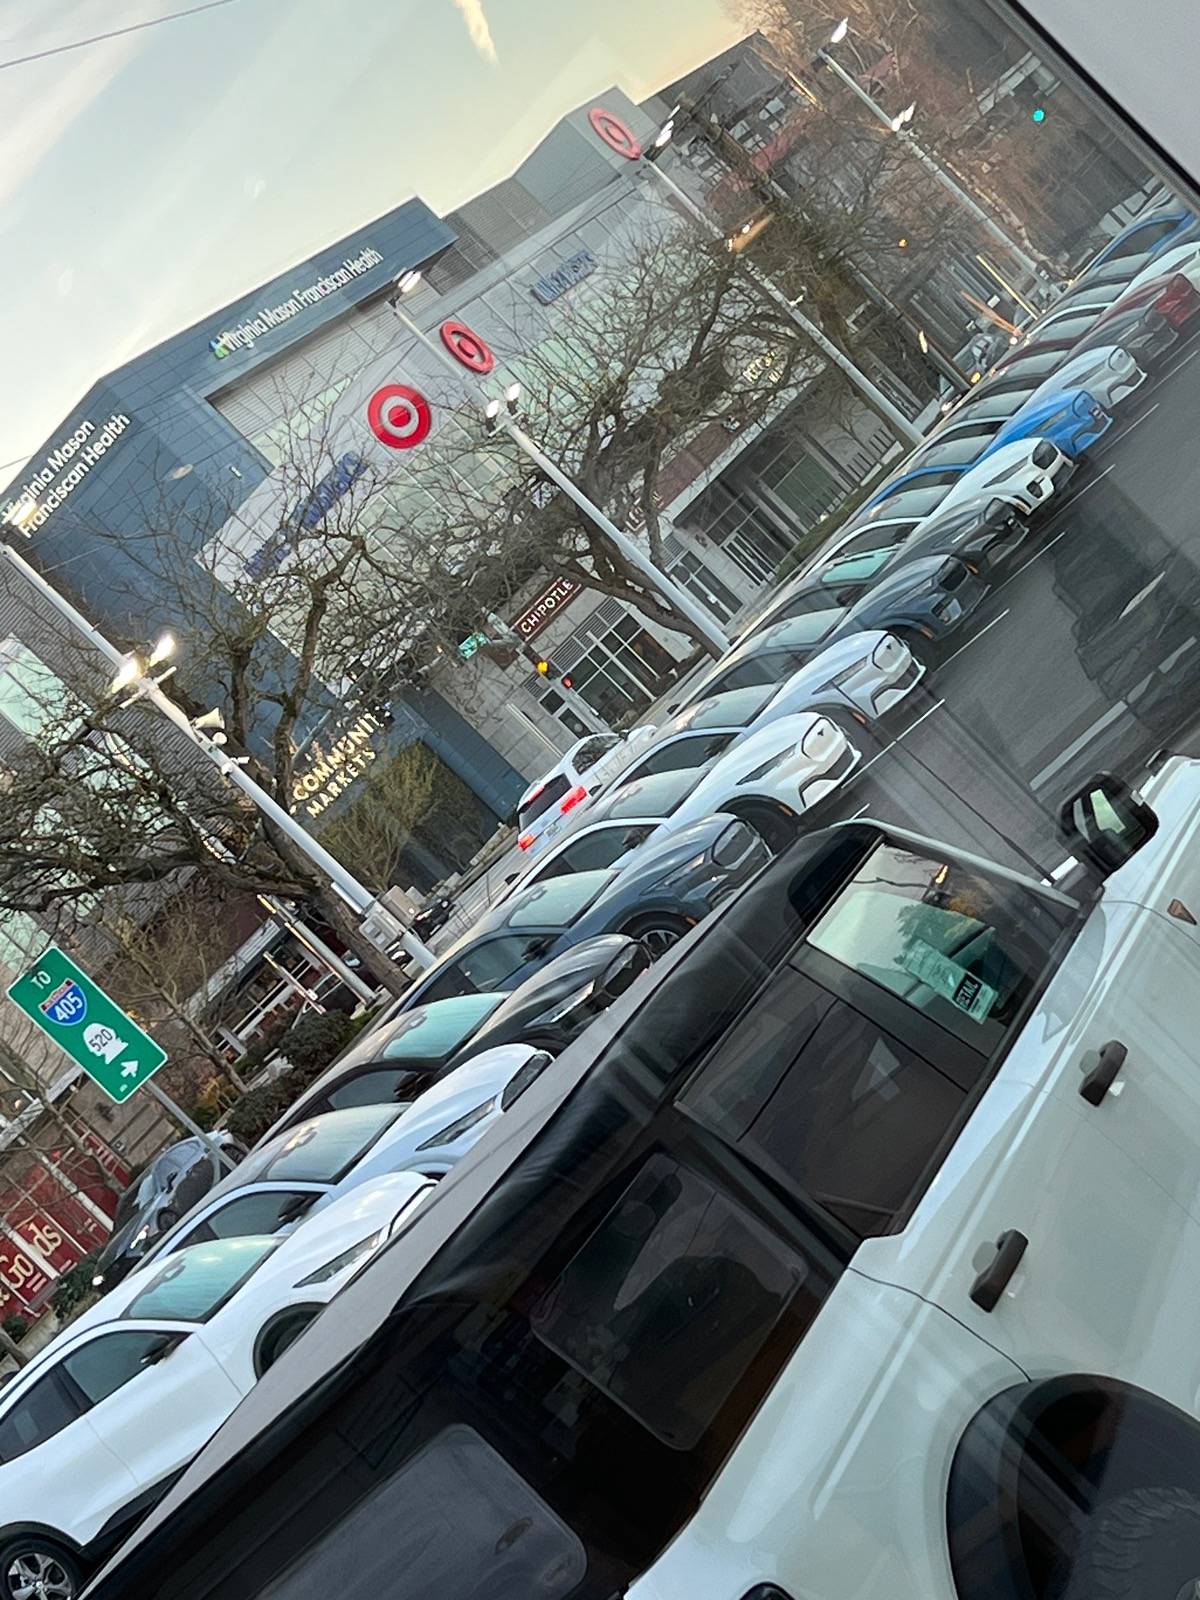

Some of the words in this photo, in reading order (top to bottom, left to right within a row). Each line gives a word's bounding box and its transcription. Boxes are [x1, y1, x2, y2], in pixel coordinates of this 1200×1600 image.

[222, 318, 269, 350] Virginia
[259, 297, 303, 327] Mason
[293, 267, 354, 310] Franciscan
[343, 247, 384, 278] Health
[18, 462, 90, 538] Franciscan
[81, 414, 130, 466] Health
[48, 421, 95, 472] Mason
[521, 579, 574, 633] CHIPOTLE
[293, 708, 384, 801] COMMUNIT
[306, 747, 376, 818] MARKETS
[30, 970, 51, 989] TO
[54, 991, 83, 1020] 405
[88, 1028, 113, 1052] 520
[0, 1222, 62, 1289] Gods
